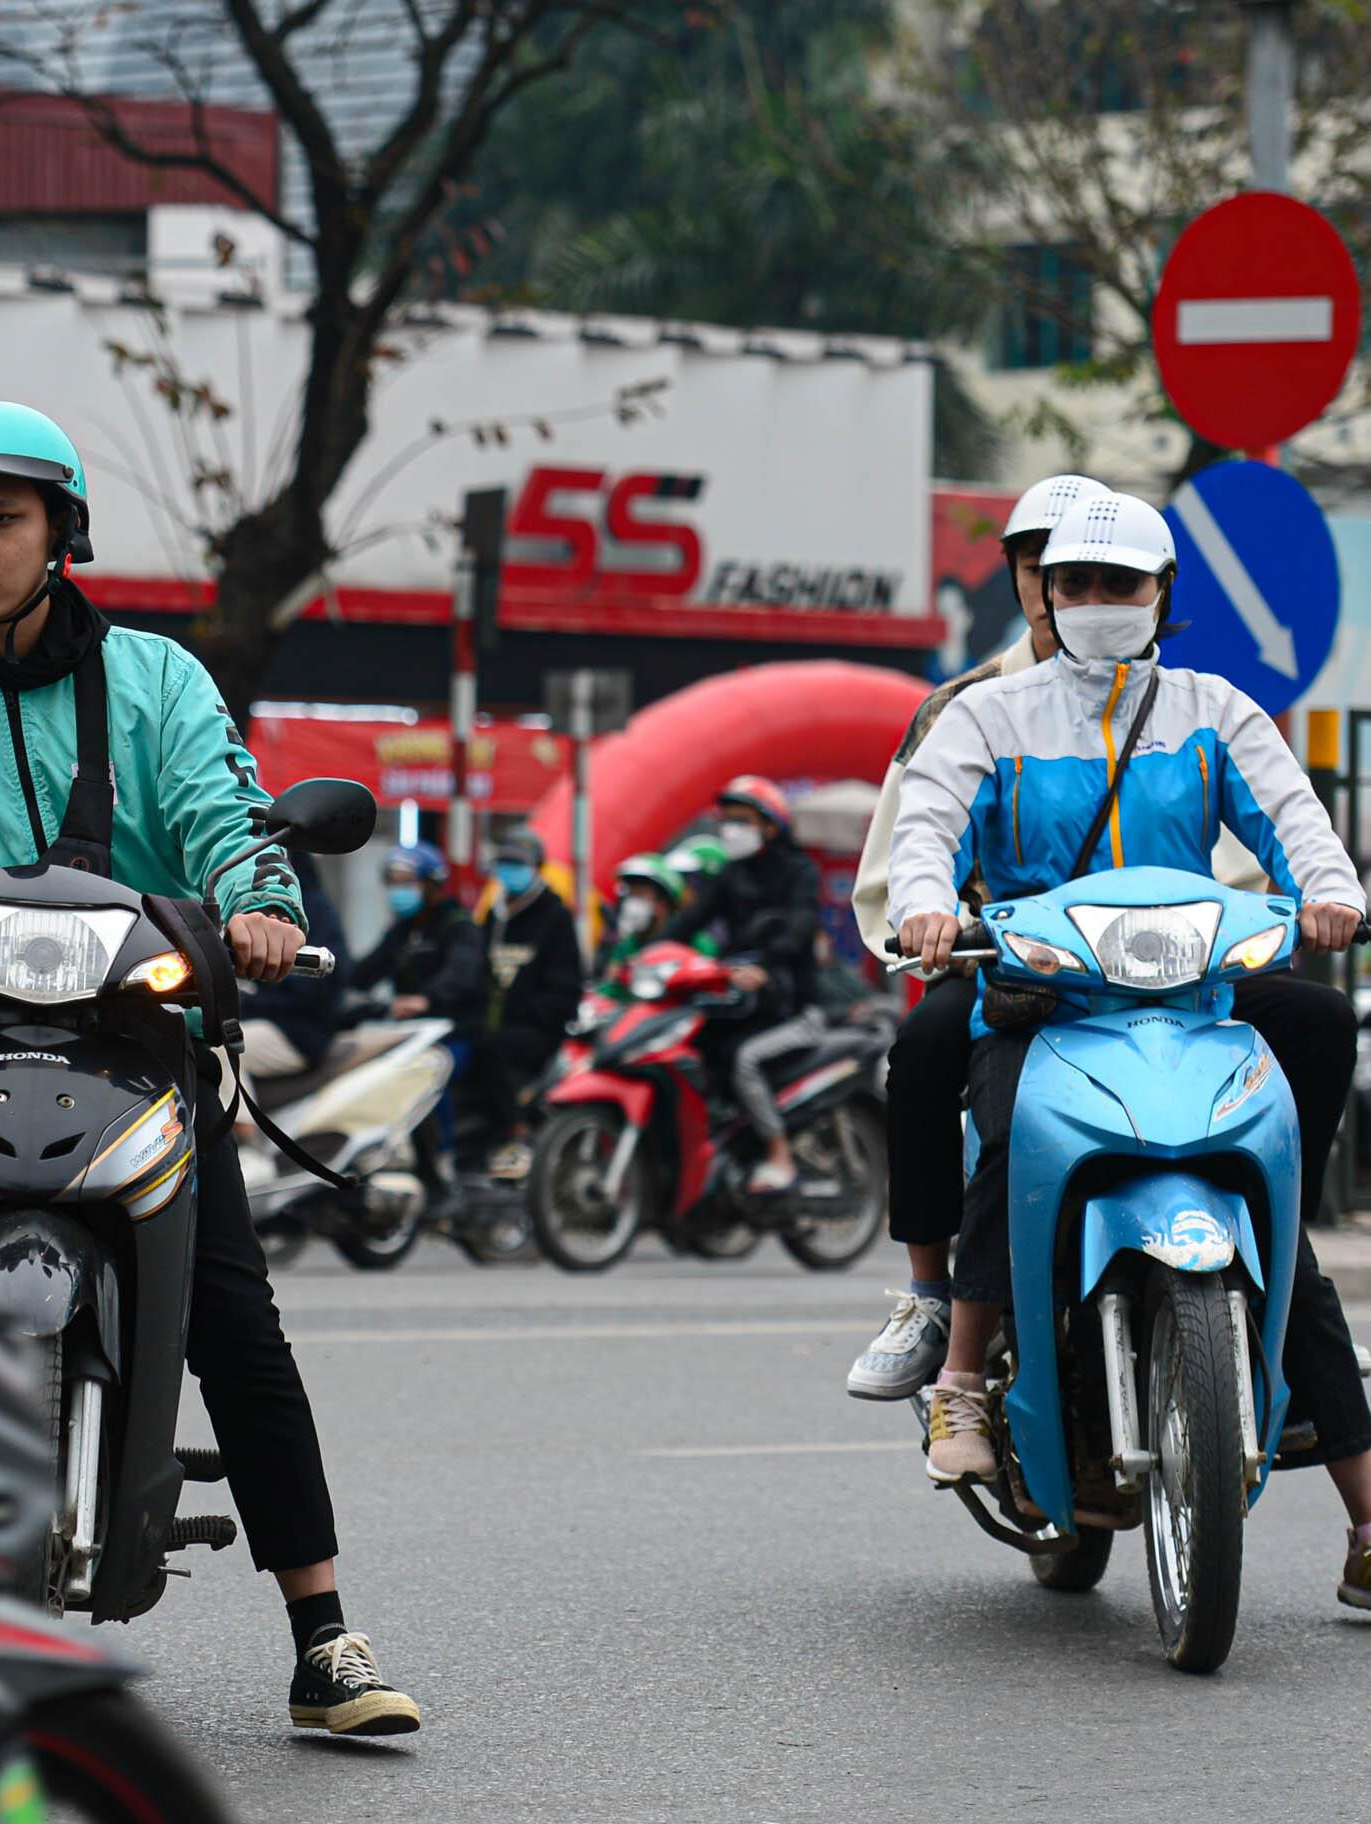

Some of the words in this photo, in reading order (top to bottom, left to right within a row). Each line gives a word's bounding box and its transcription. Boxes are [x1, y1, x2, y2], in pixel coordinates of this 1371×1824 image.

[500, 464, 708, 598] 5S
[705, 560, 904, 606] FASHION
[1127, 1015, 1186, 1028] HONDA
